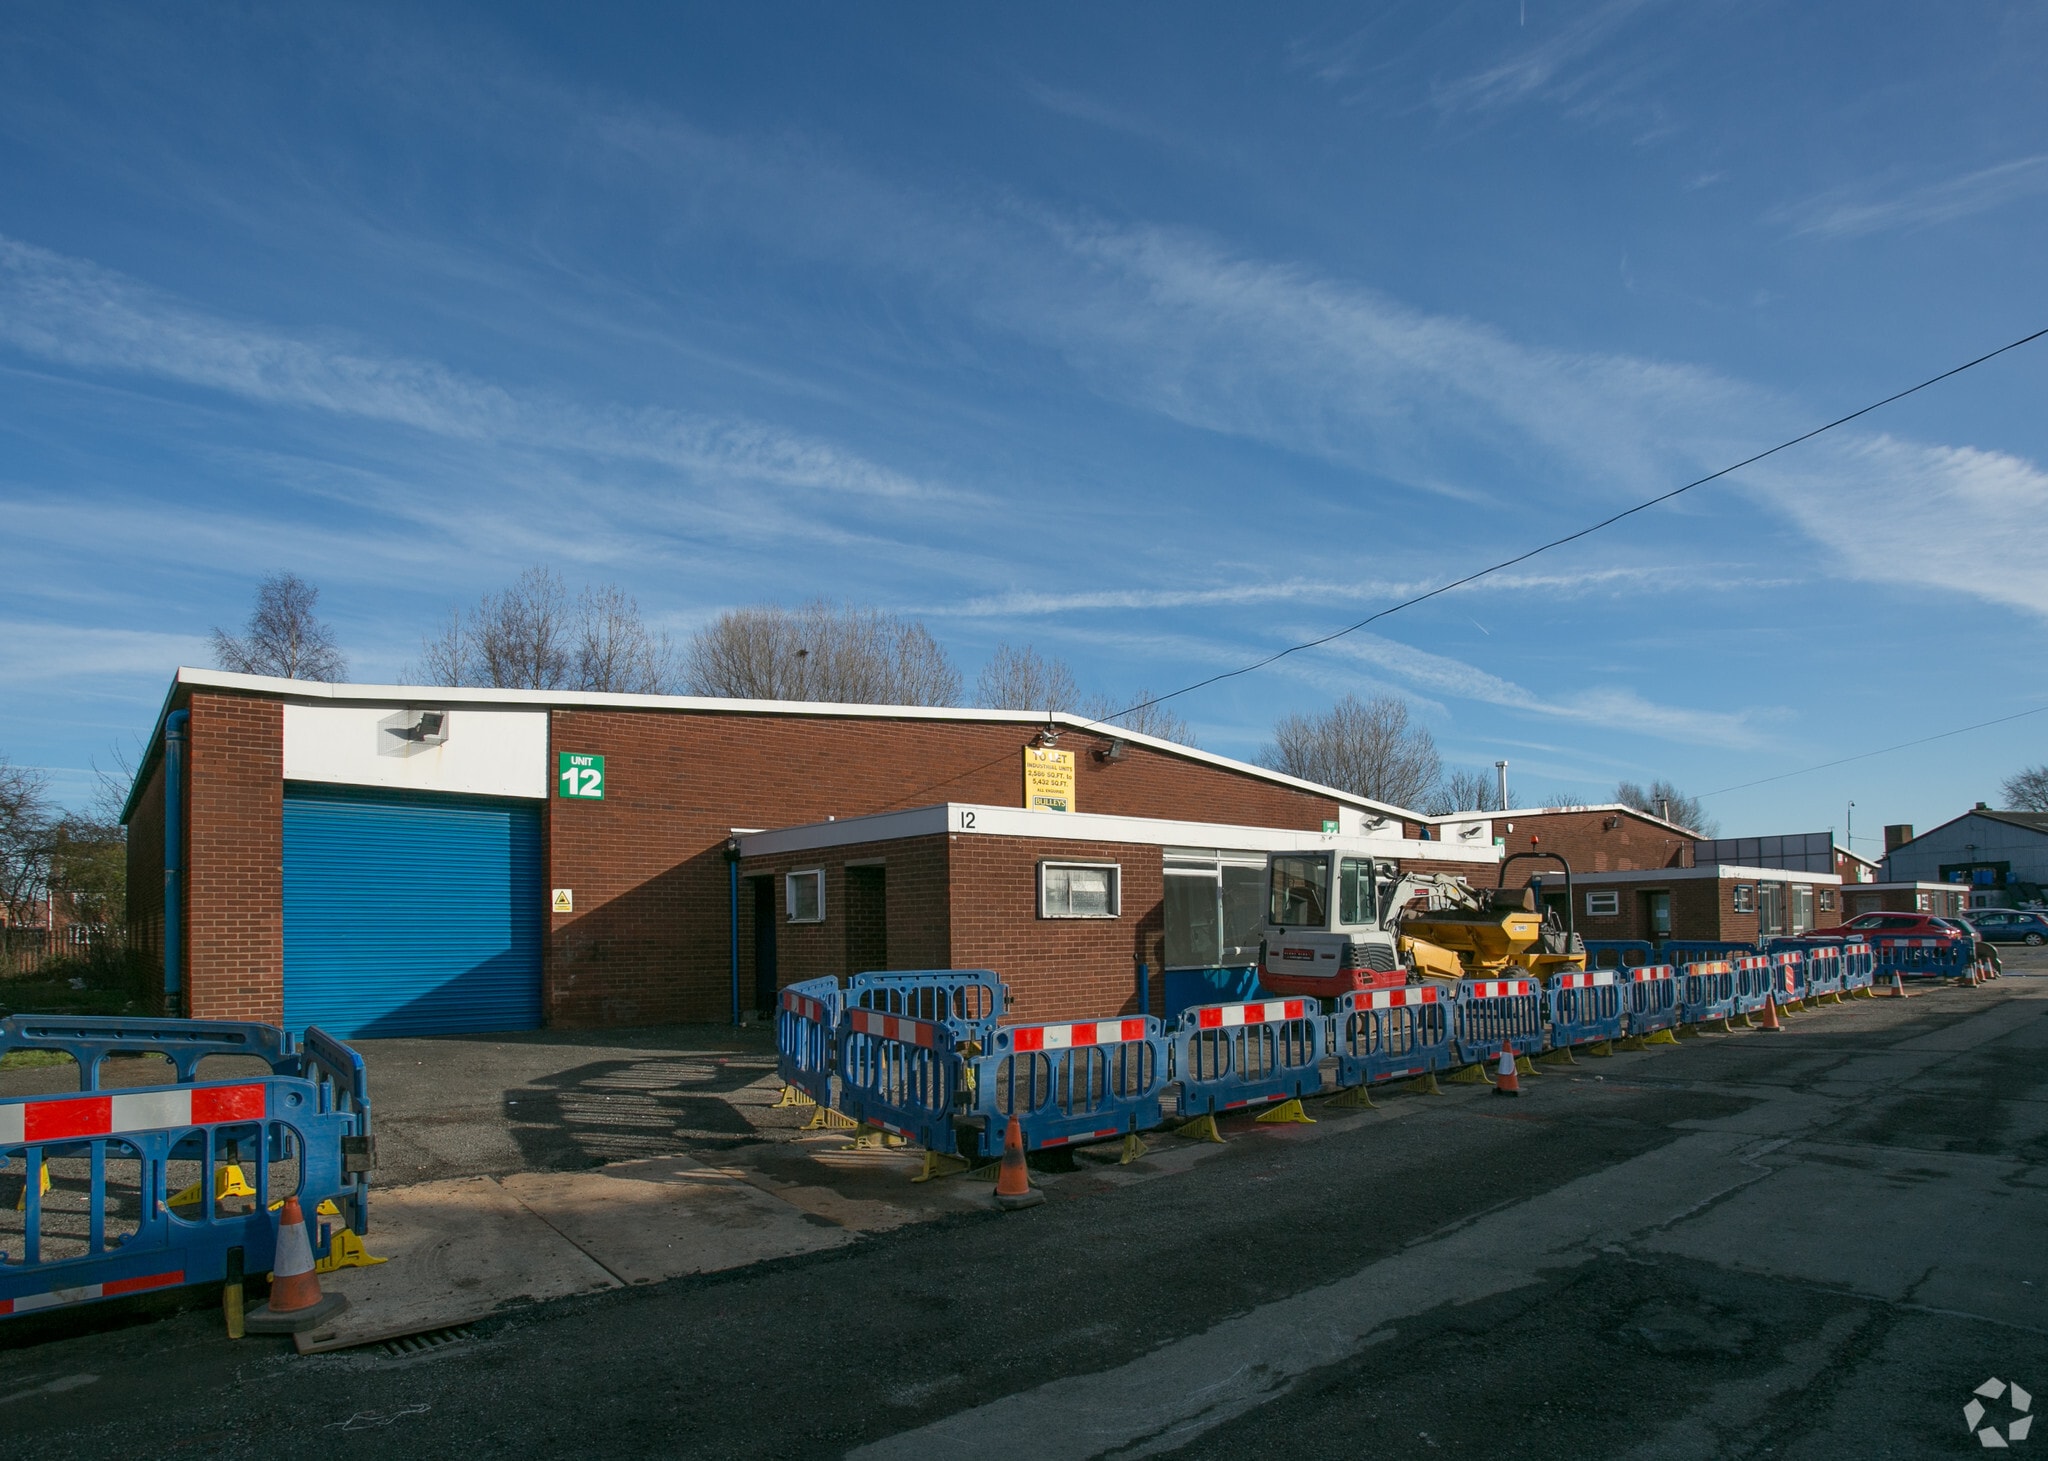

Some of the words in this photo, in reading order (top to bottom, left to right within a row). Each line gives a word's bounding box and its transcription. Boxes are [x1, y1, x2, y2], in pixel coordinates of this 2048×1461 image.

[570, 756, 593, 766] UNIT
[562, 767, 602, 797] 12
[1036, 798, 1065, 807] BULLEYS
[961, 811, 976, 829] 12
